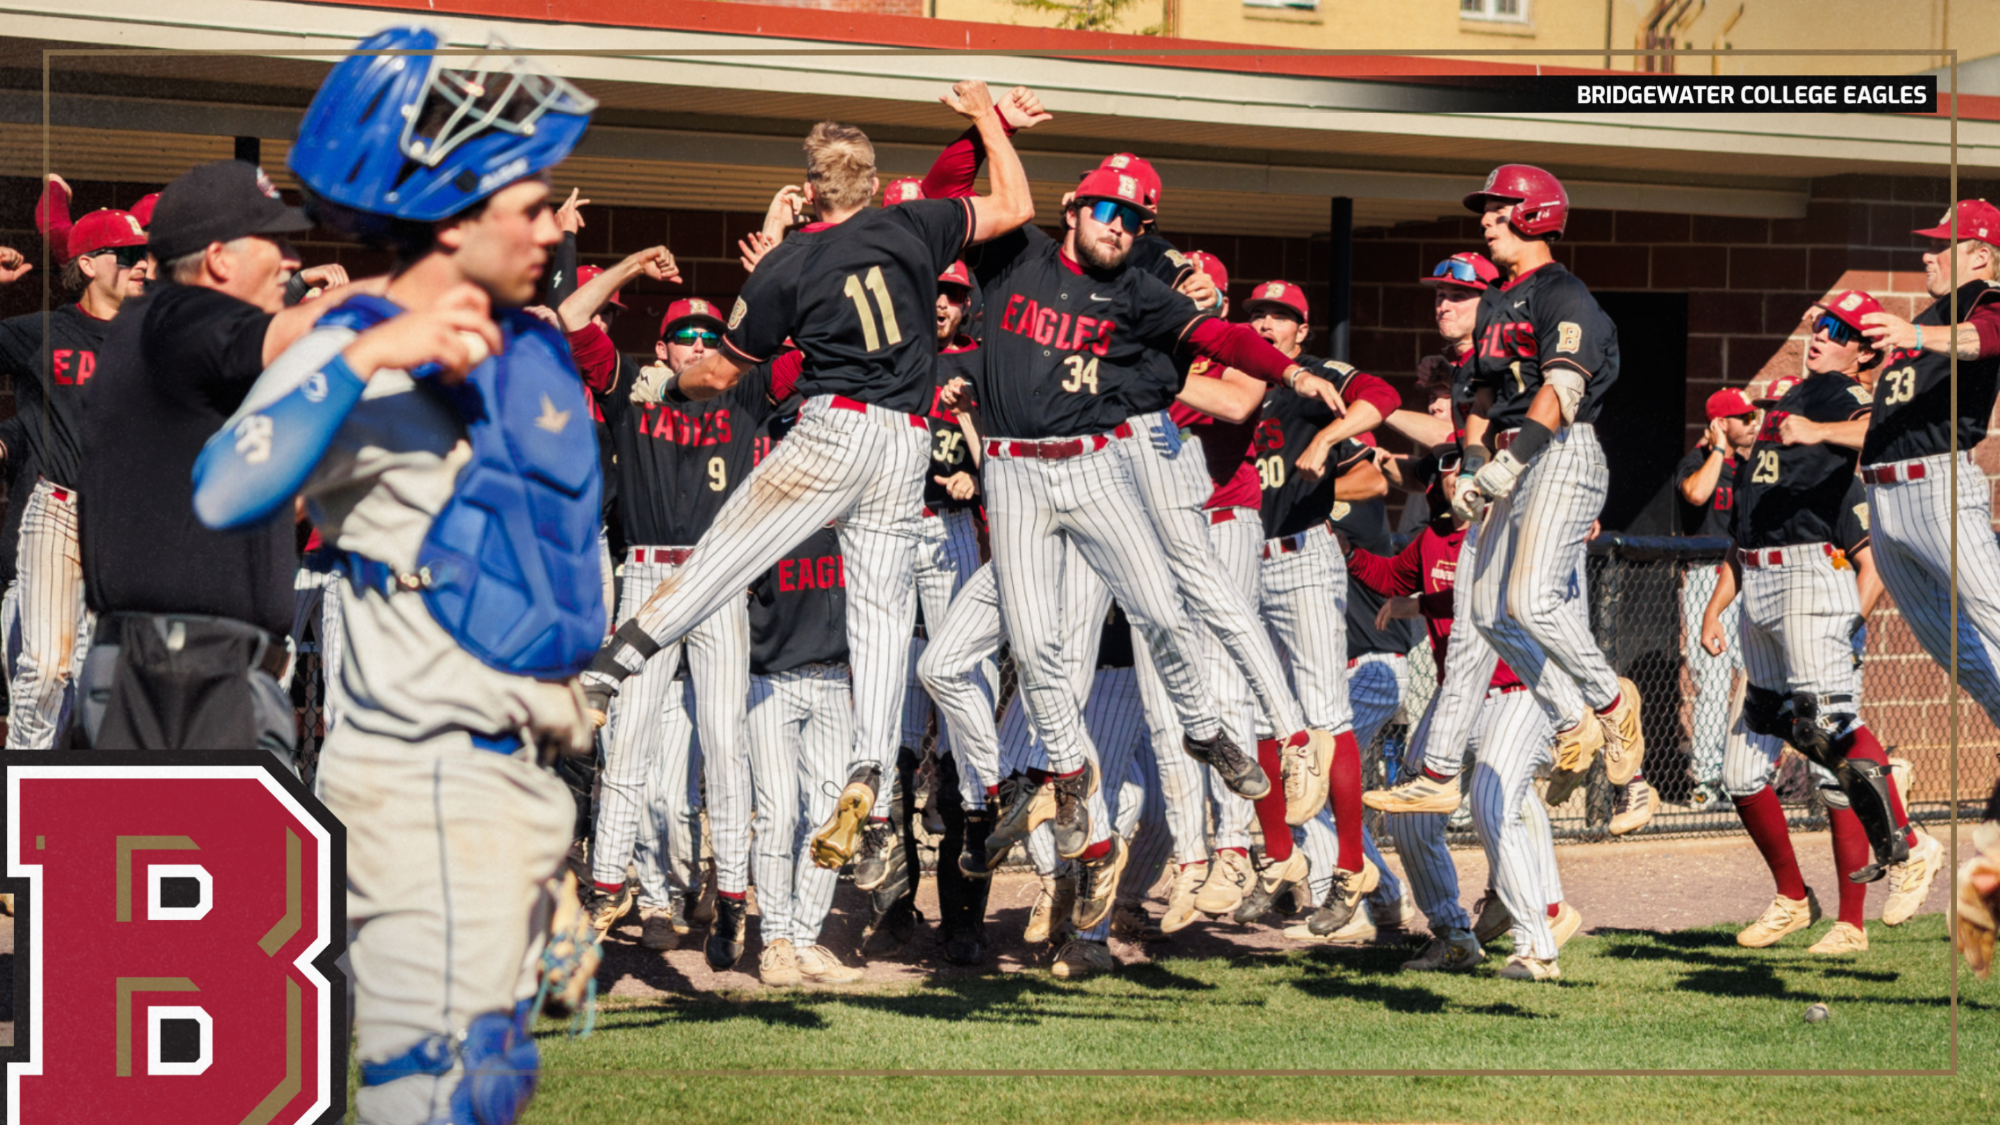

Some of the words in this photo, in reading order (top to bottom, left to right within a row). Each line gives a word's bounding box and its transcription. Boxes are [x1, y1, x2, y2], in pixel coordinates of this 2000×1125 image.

[843, 265, 902, 352] 11
[1000, 293, 1116, 356] EAGLES
[1557, 321, 1582, 354] B
[1061, 354, 1099, 394] 34
[1885, 366, 1916, 406] 33
[932, 429, 965, 465] 35
[707, 456, 727, 491] 9
[1254, 455, 1285, 490] 30
[1751, 449, 1779, 484] 29
